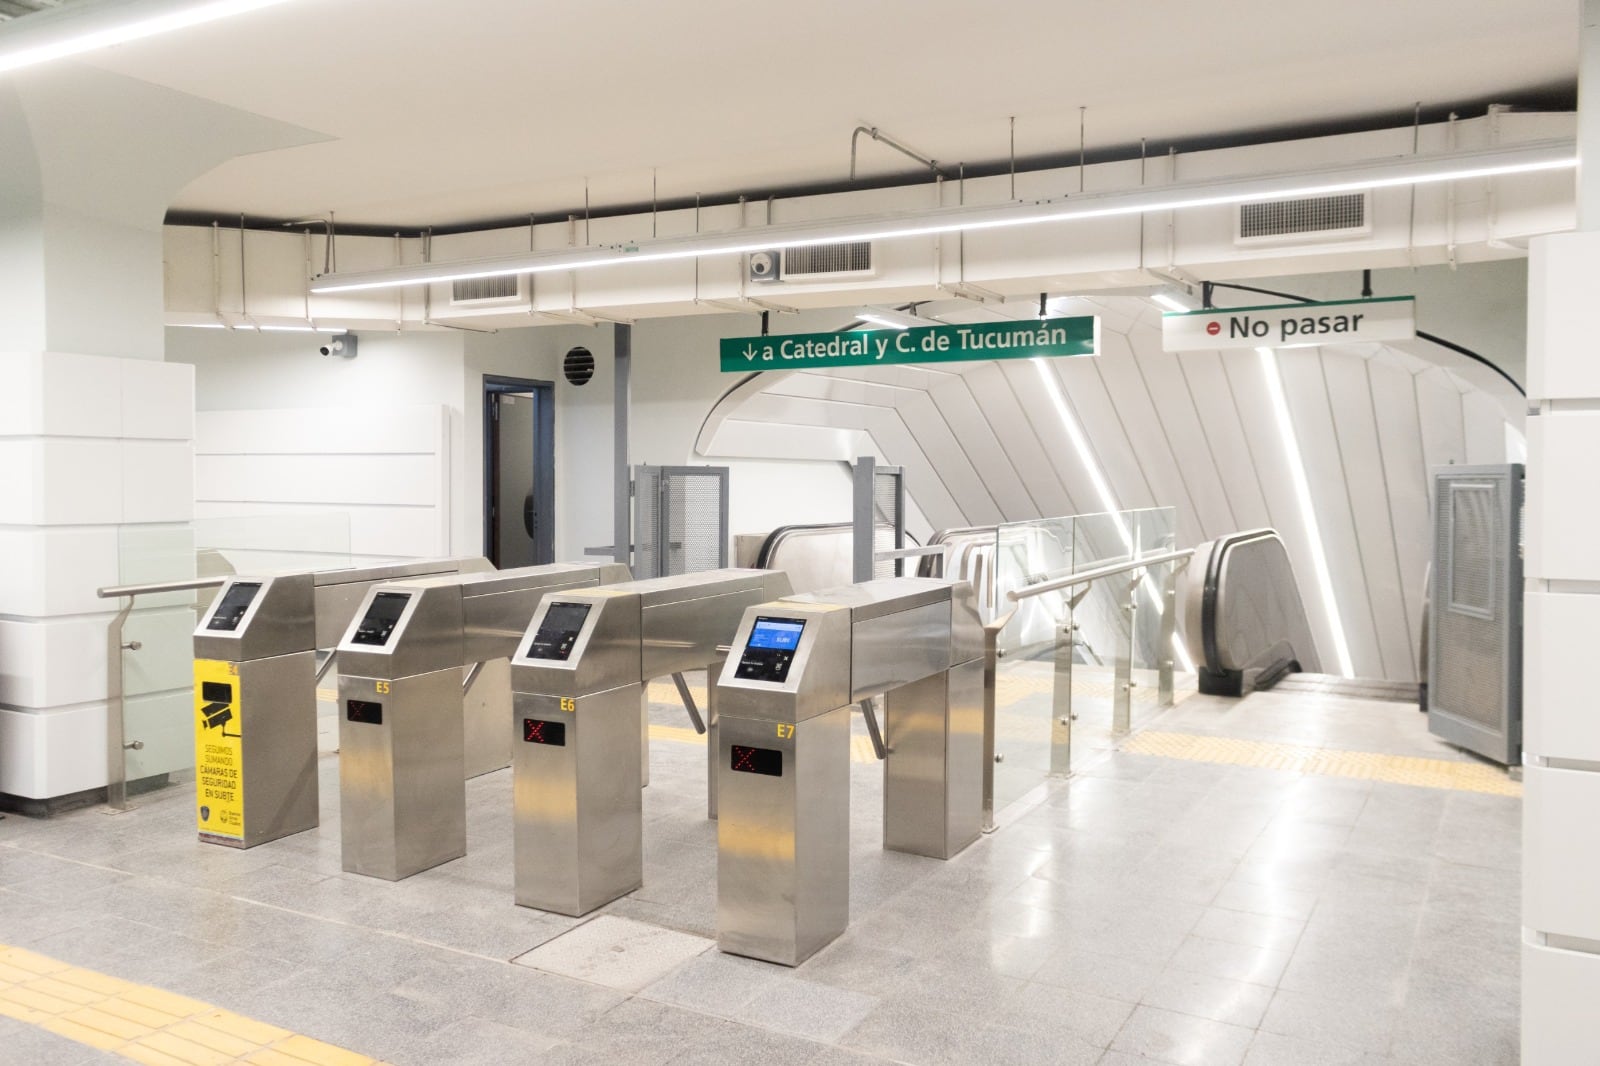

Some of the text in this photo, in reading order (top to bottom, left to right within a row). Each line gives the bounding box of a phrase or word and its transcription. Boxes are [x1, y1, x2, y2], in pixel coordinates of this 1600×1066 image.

[1230, 313, 1364, 341] No pasar
[762, 323, 1067, 361] a Catedral y C. de Tucumán
[376, 682, 389, 694] E5
[560, 697, 574, 711] E6
[776, 723, 795, 739] E7
[205, 744, 232, 755] SEGUIMOS
[205, 755, 232, 766] SUMANDO
[200, 763, 238, 779] CÁMARAS DE
[202, 776, 236, 789] SEGURIDAD
[205, 788, 234, 801] EN SUBTE
